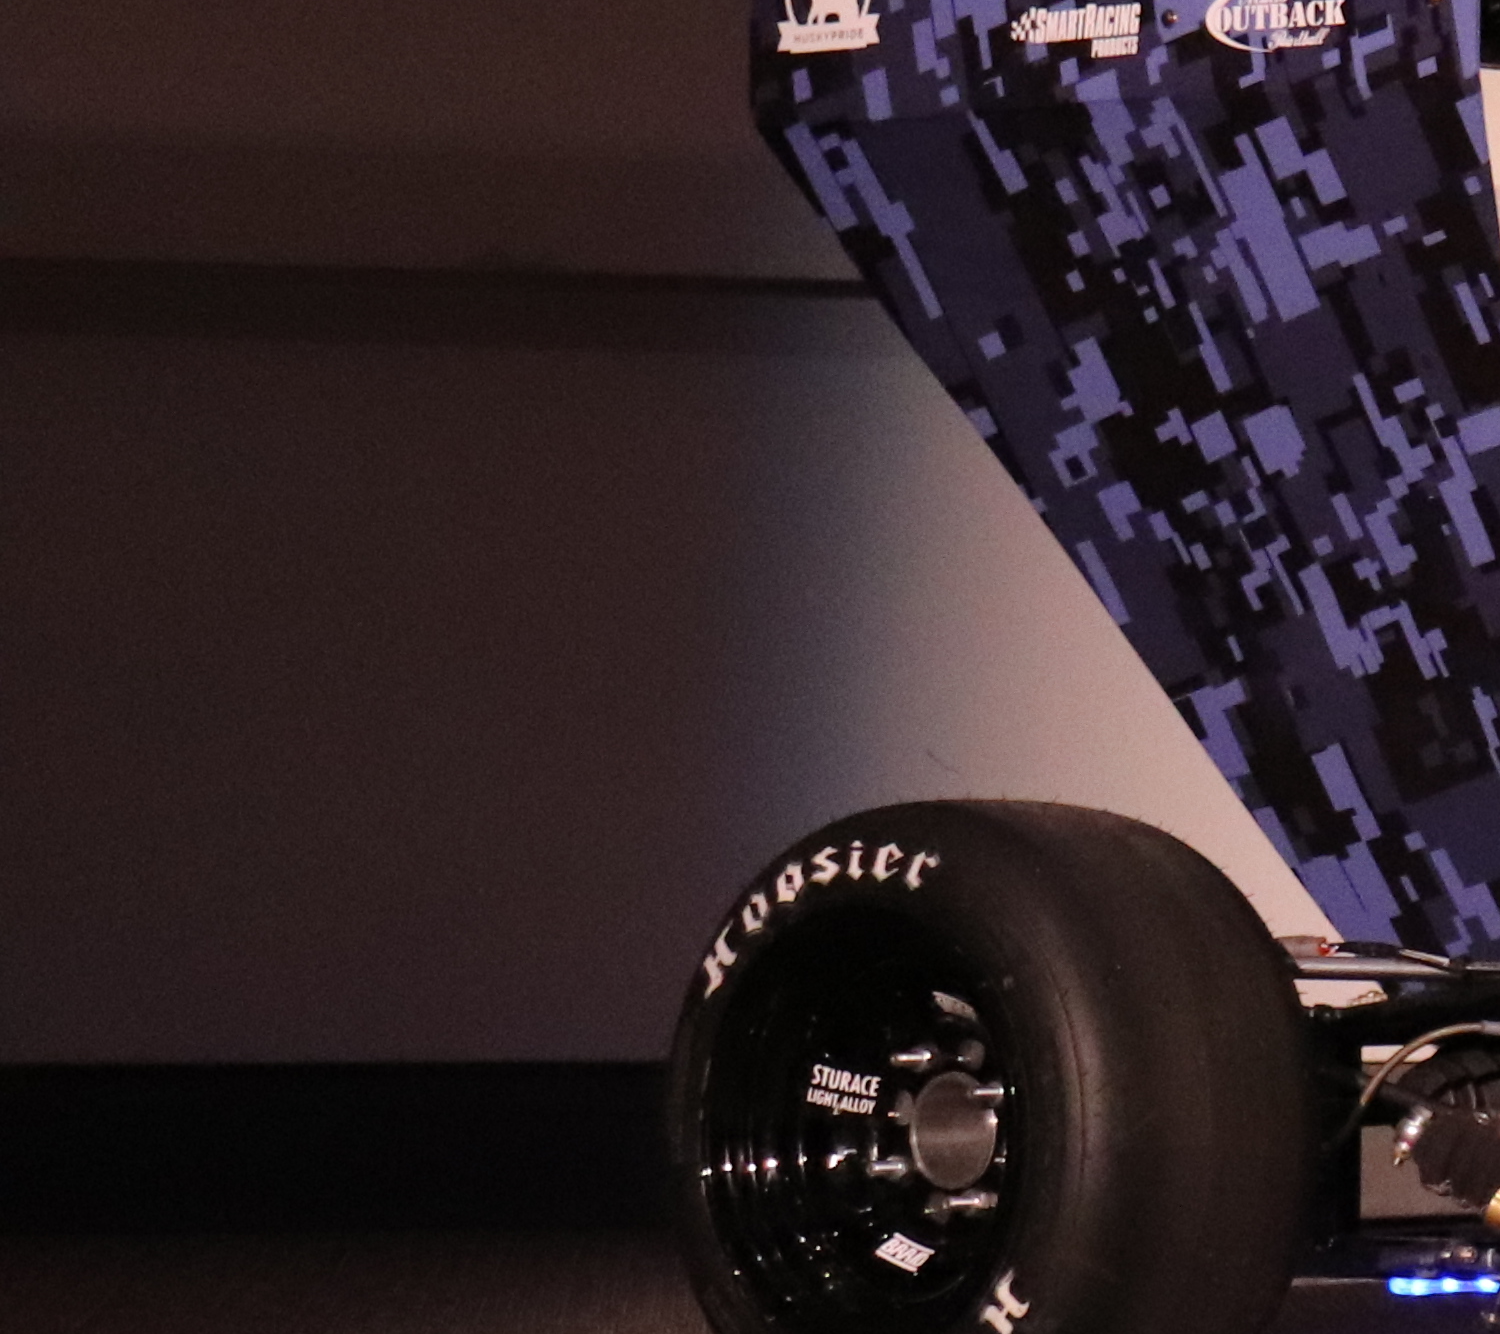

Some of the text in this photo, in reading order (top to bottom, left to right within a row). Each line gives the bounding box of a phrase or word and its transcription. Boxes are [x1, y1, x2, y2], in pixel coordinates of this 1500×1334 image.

[811, 1064, 882, 1098] STURACE
[806, 1087, 877, 1115] LIGHT ALLOY
